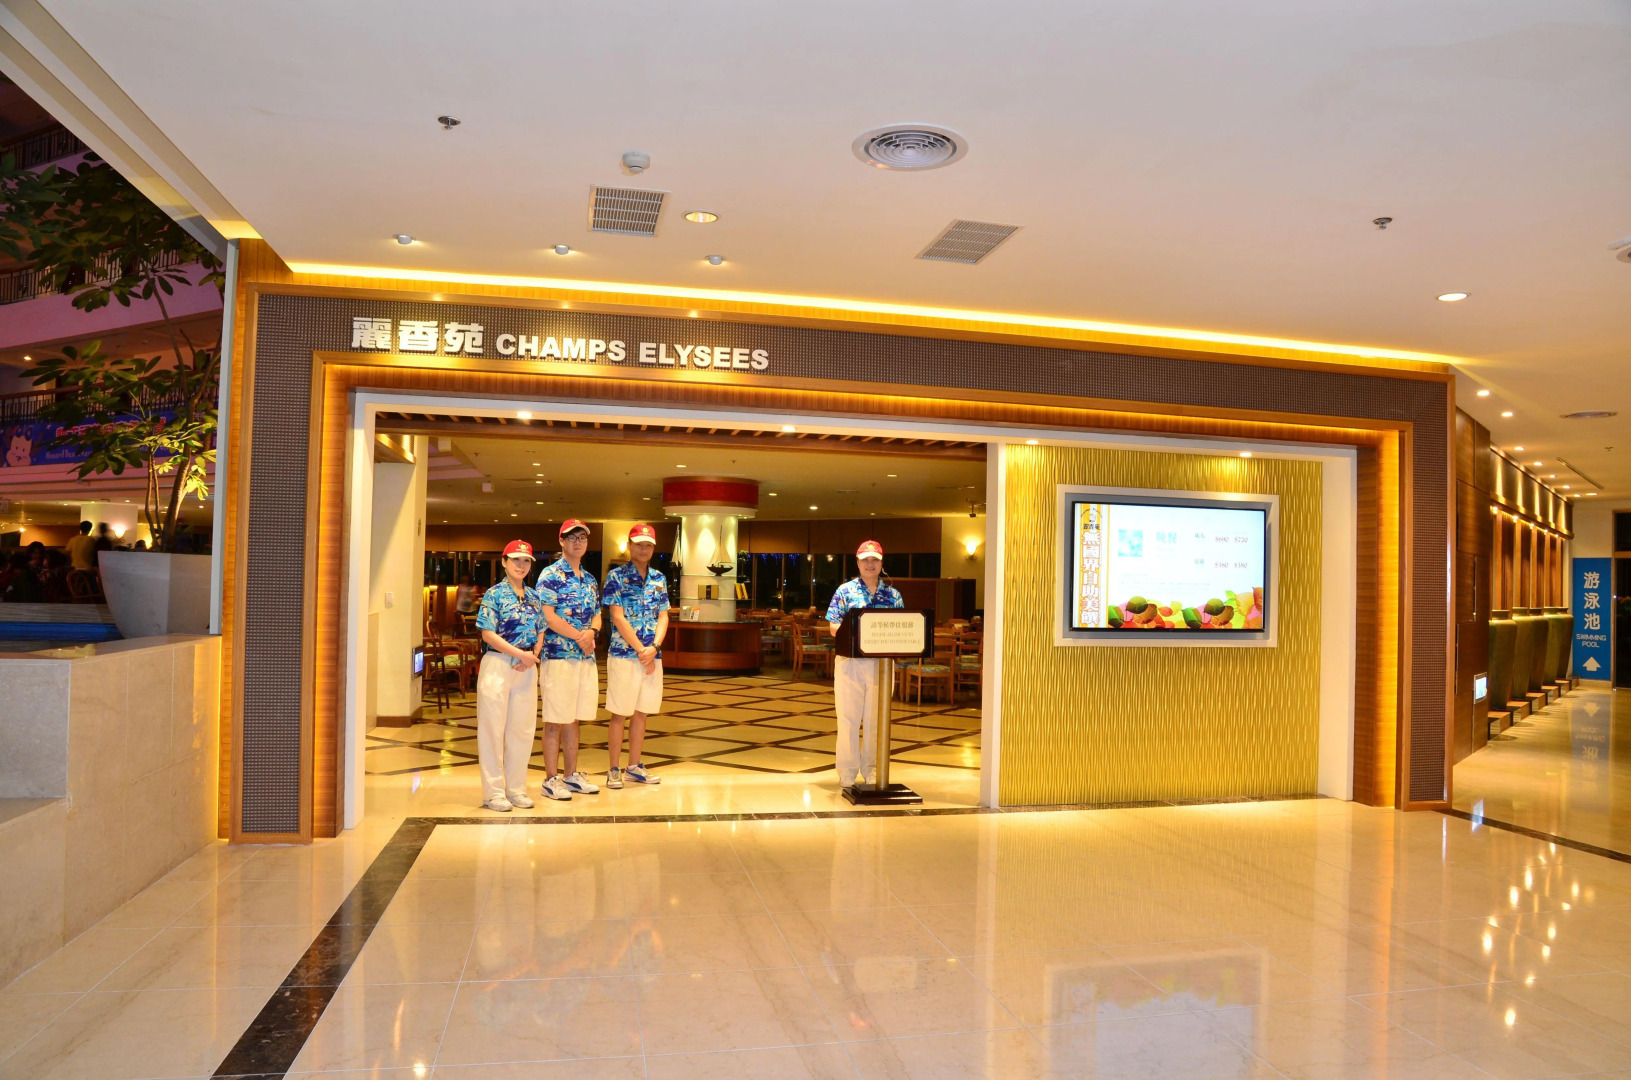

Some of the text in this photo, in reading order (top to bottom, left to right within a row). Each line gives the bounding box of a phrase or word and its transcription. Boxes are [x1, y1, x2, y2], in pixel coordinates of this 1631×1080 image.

[352, 317, 483, 353] 麗香苑
[496, 334, 769, 370] CHAMPS ELYSEES
[1584, 571, 1601, 630] 游泳池
